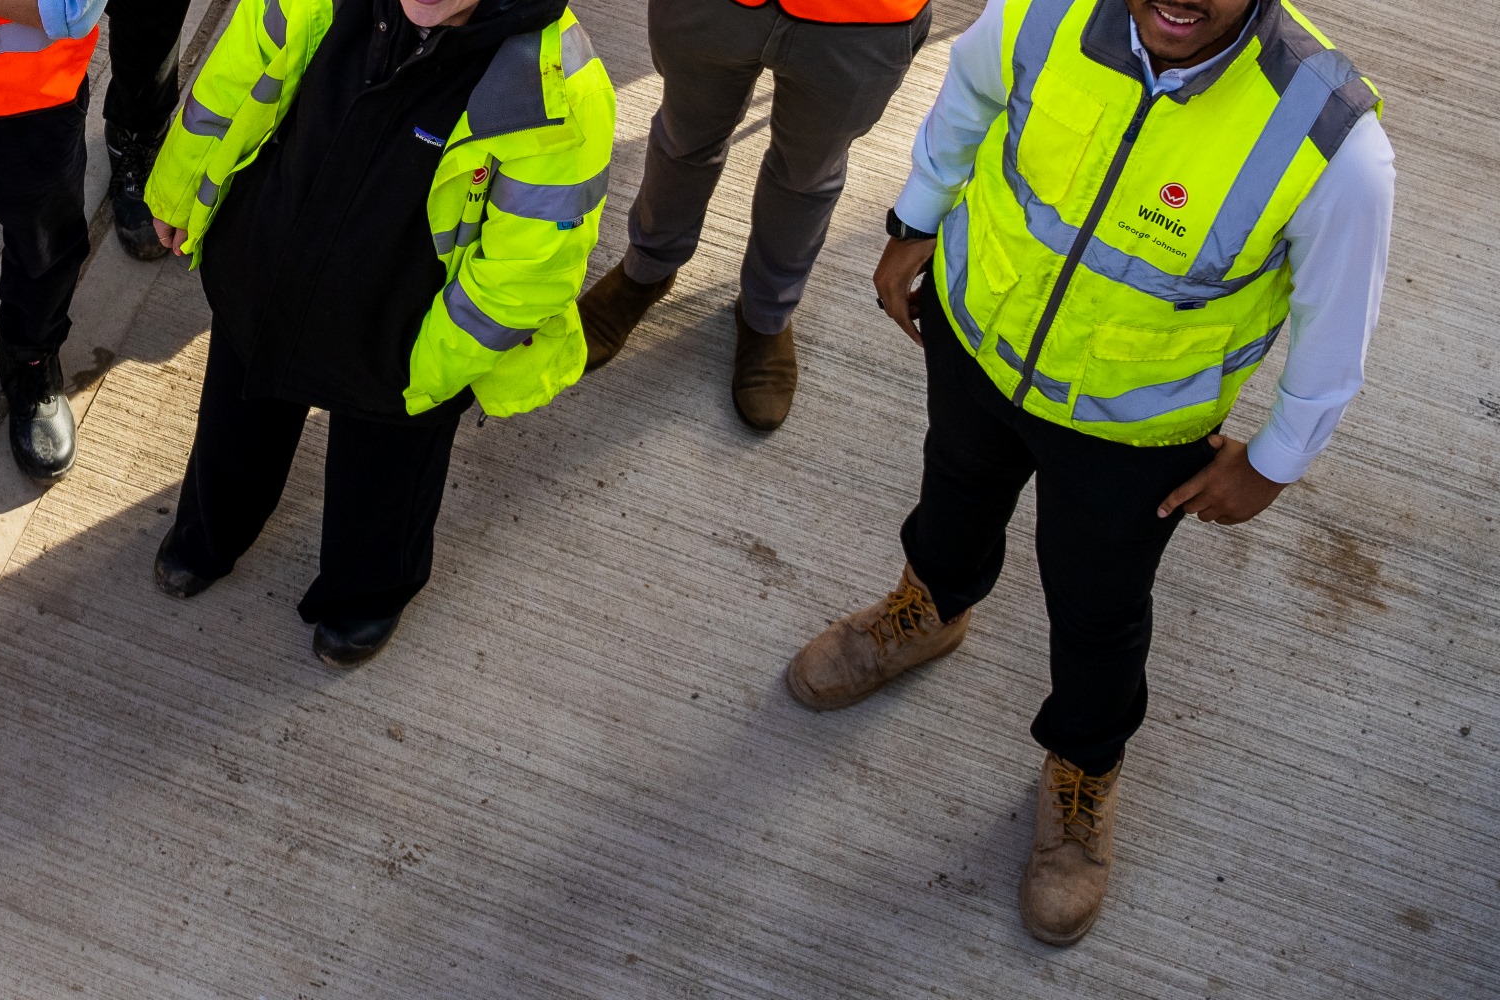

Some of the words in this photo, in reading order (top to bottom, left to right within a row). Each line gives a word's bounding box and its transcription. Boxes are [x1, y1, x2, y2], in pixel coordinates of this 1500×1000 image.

[1137, 204, 1187, 238] winvic
[1117, 220, 1151, 239] George
[1151, 237, 1188, 259] Johnson
